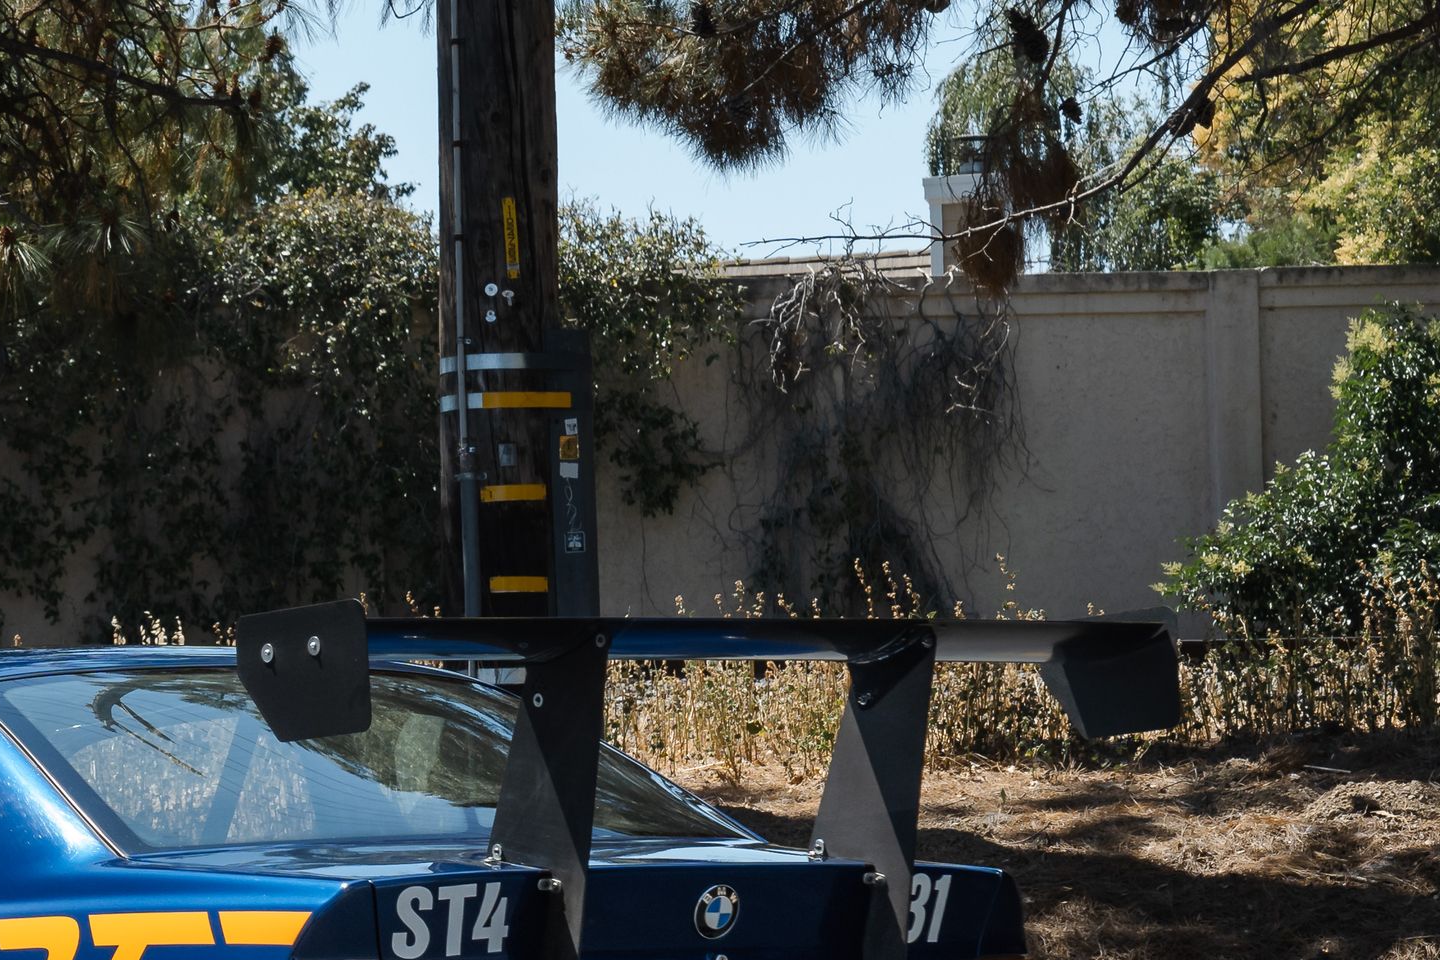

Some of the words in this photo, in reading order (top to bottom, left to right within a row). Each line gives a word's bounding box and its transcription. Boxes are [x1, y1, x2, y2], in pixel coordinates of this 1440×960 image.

[391, 881, 509, 960] ST4
[702, 886, 738, 904] BMW
[907, 872, 952, 944] 31
